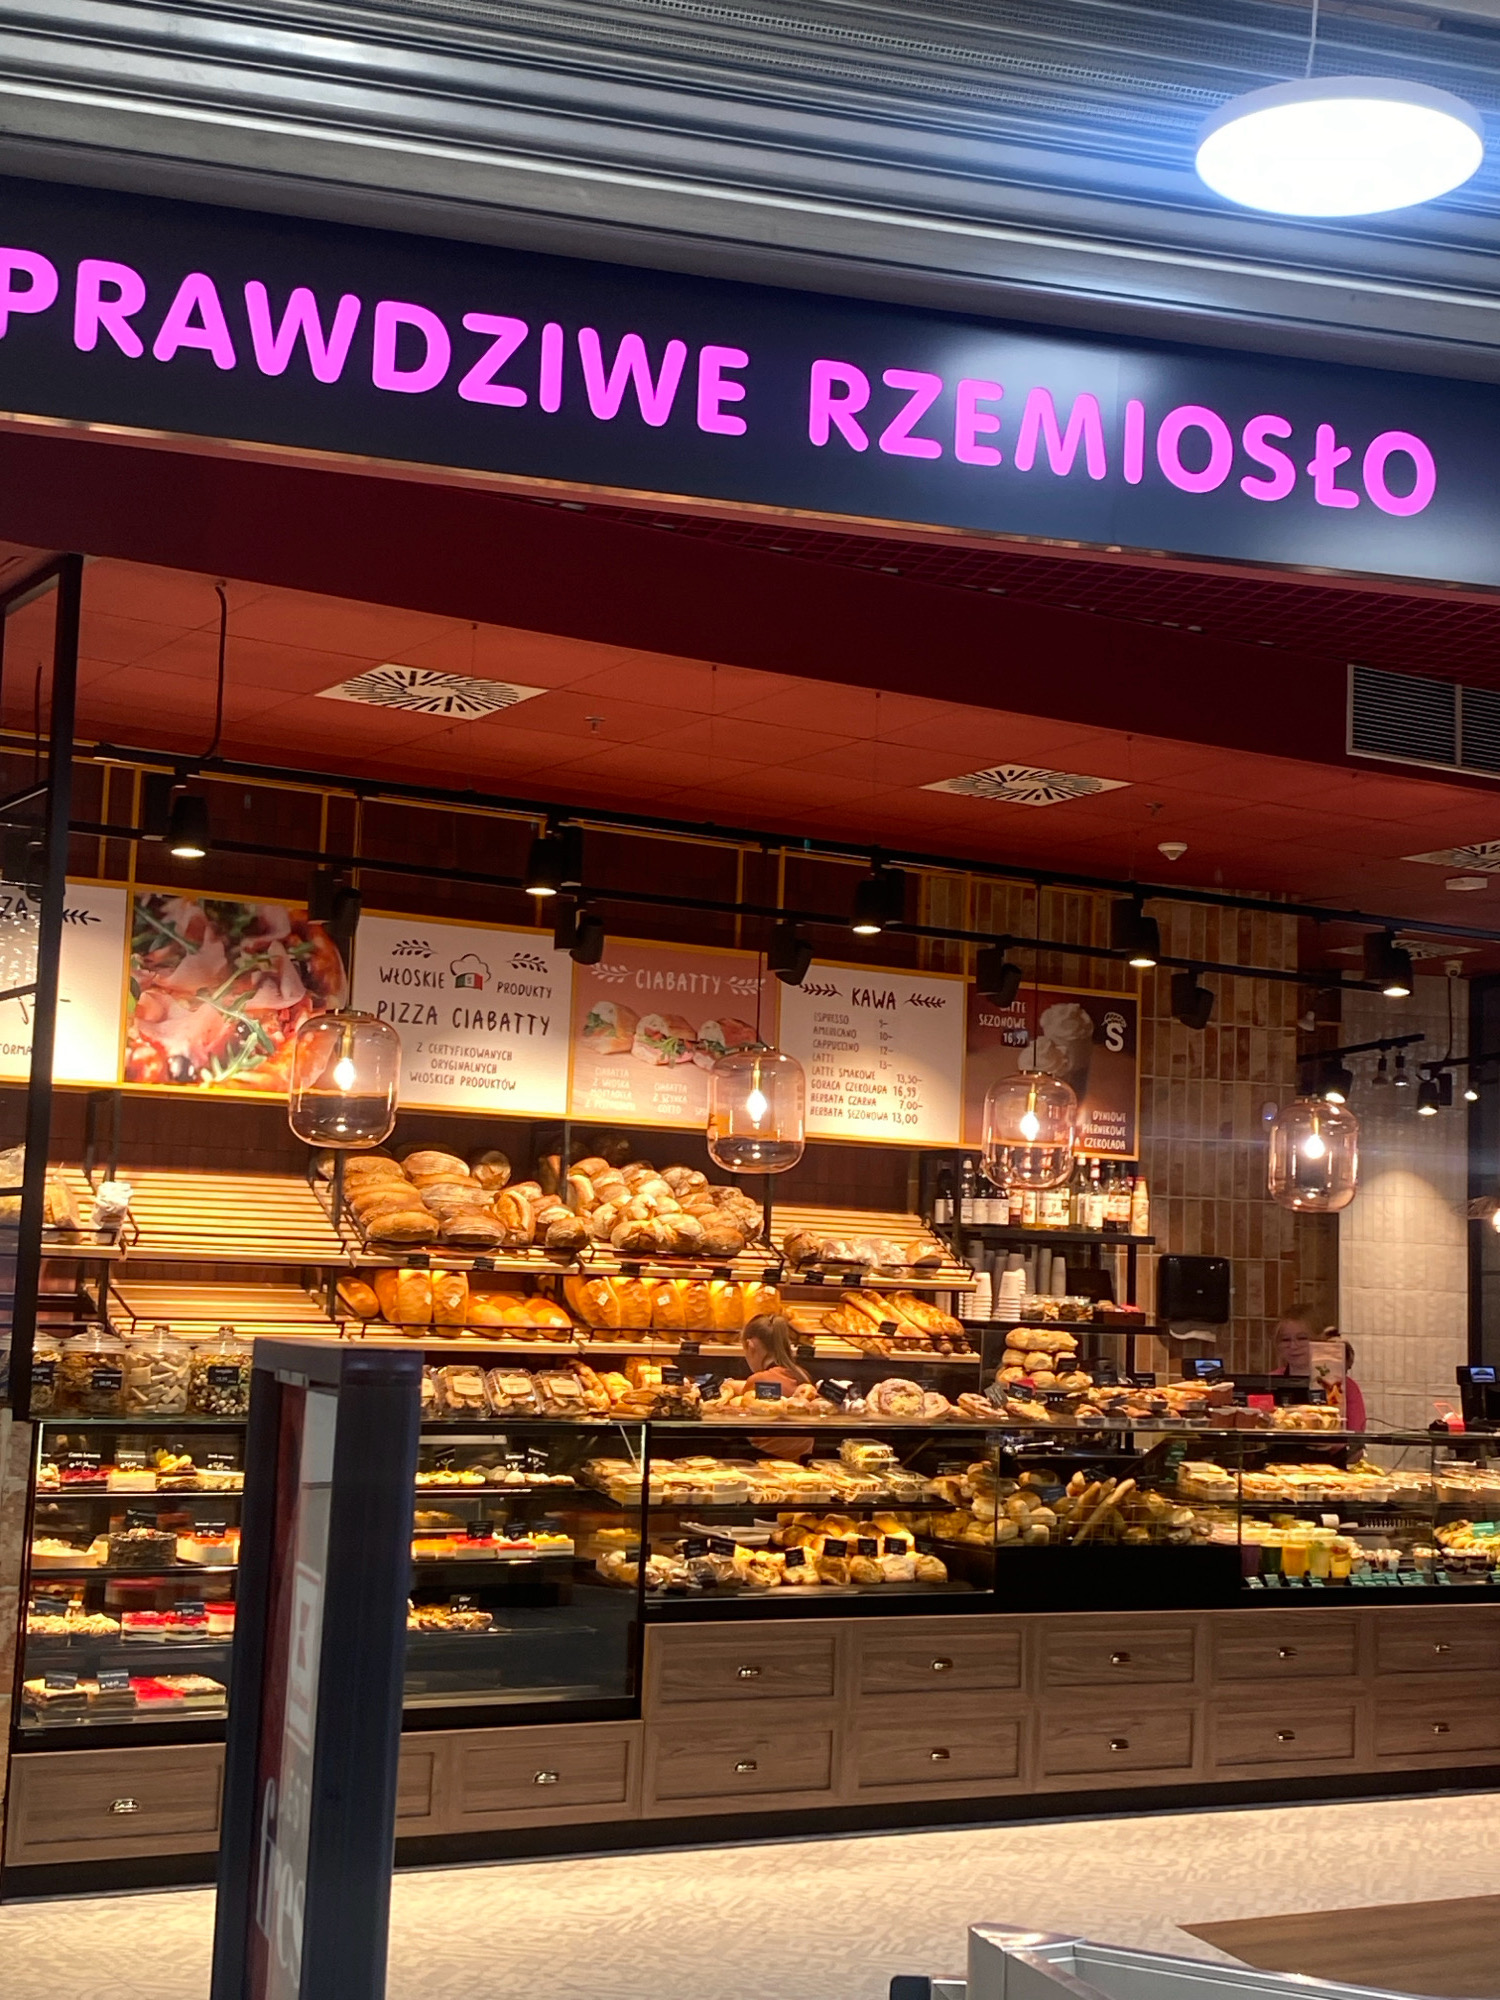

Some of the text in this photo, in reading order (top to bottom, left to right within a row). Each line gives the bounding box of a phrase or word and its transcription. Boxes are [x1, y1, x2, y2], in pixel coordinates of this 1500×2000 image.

[0, 247, 1437, 517] PRAWDZIWE RZEMIOSŁO
[379, 966, 552, 999] WŁOSKIE PRODUKTY
[635, 968, 721, 995] CIABATTY
[851, 987, 897, 1010] KAWA
[376, 1000, 550, 1036] PIZZA CIABATTY
[813, 1012, 849, 1024] ESPRESSO
[978, 1013, 1026, 1029] SEZONOWE
[813, 1026, 857, 1039] AMERICANO
[416, 1042, 513, 1061] Z CERTYFIKOWANYCH
[812, 1039, 860, 1053] CAPPUCCINO
[430, 1058, 497, 1074] ORYGINALNYCH
[812, 1053, 834, 1064] LATTE
[409, 1071, 517, 1090] WŁOSKICH PRODUKTÓW
[812, 1066, 834, 1077] LATTE
[838, 1068, 876, 1081] SMAKOWE
[845, 1081, 887, 1095] CZEKOLADA
[893, 1086, 916, 1100] 16,99
[848, 1095, 877, 1106] CZARNA
[847, 1109, 888, 1121] SEZONOWA
[892, 1111, 918, 1125] 13,00
